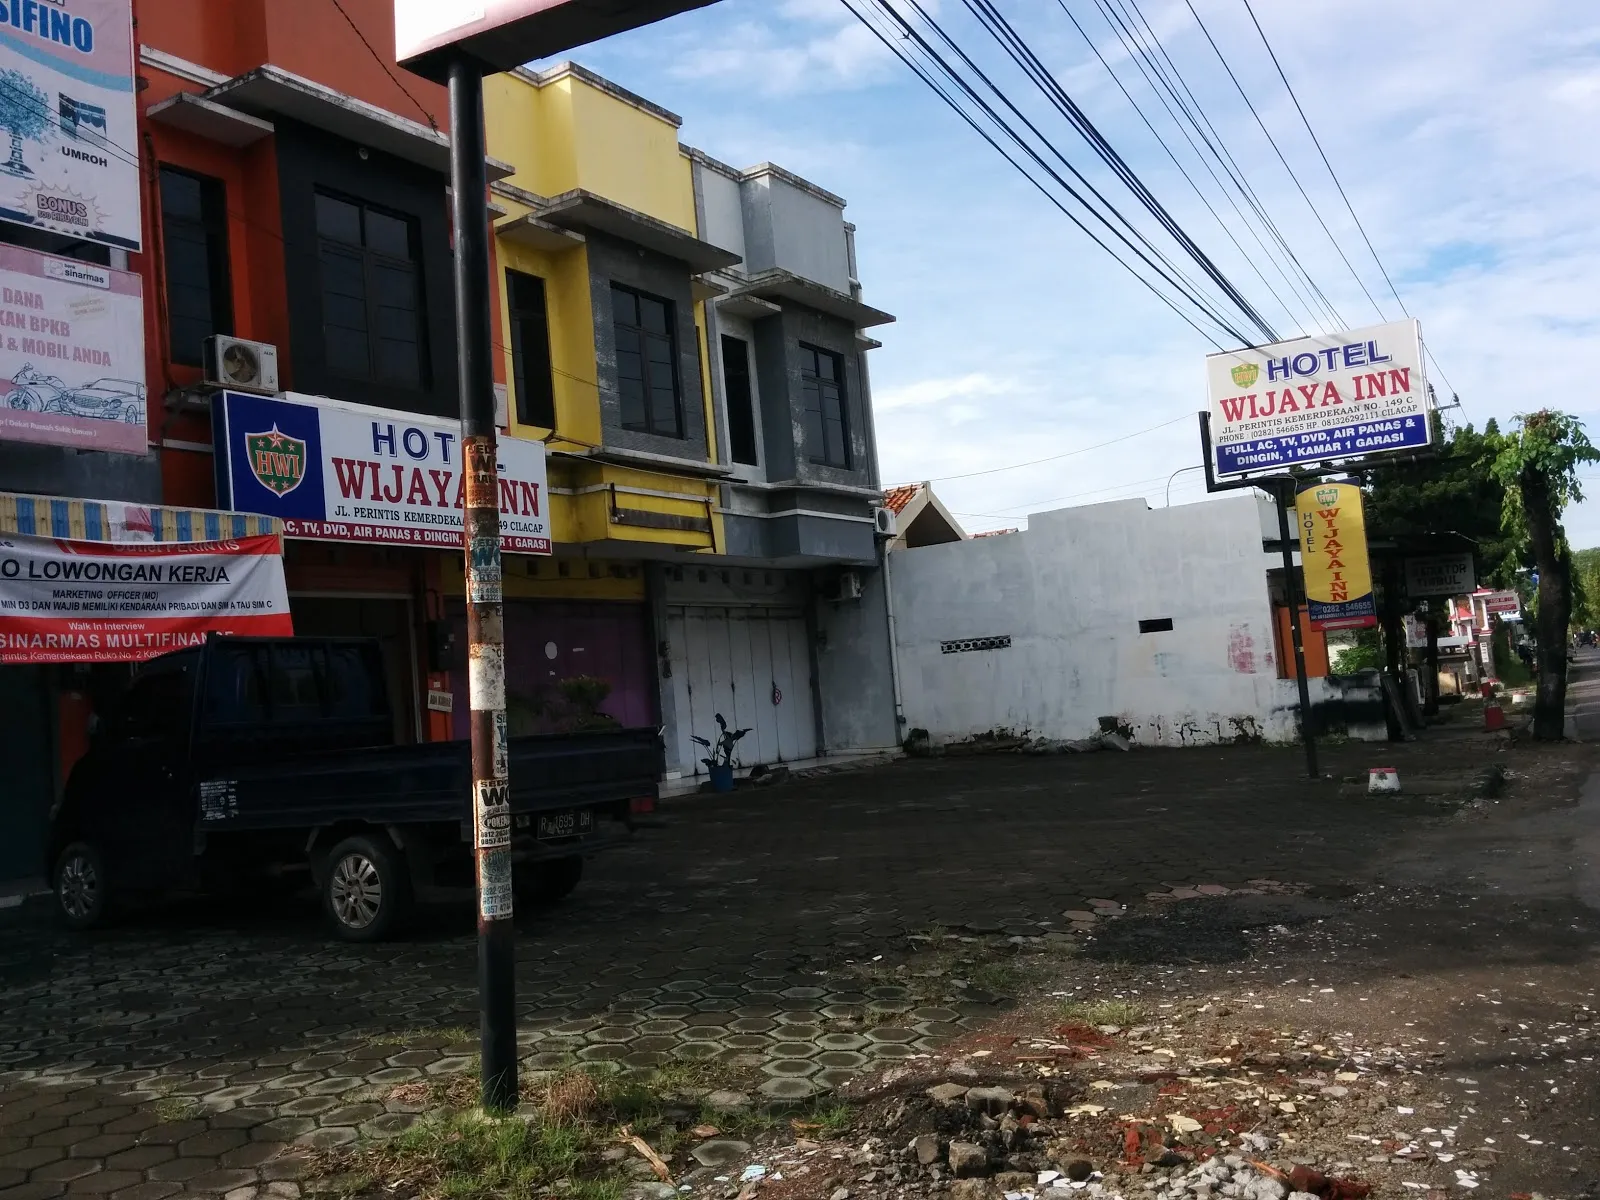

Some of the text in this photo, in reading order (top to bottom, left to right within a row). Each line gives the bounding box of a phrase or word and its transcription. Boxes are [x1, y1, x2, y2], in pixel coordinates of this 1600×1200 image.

[61, 146, 108, 168] UMROH
[36, 194, 88, 217] BONUS
[64, 268, 105, 284] sinarmas
[3, 288, 45, 311] DANA
[30, 315, 71, 338] BPKB
[7, 337, 112, 367] & MOBIL ANDA
[1266, 339, 1393, 383] HOTEL
[1219, 367, 1411, 423] WIJAYA INN
[1219, 433, 1245, 443] PHONE
[1251, 428, 1274, 439] (0282)
[1276, 422, 1304, 435] 546655
[1381, 404, 1418, 418] CILACAP
[1222, 396, 1414, 434] JL. PERINTIS KEMERDEKAAN NO. 149 C
[1224, 418, 1416, 456] FULL AC, TV, DVD, AIR PANAS &
[1236, 433, 1405, 466] DINGIN, 1 KAMAR 1 GARASI
[254, 449, 301, 479] HWI
[498, 478, 540, 518] NN
[334, 504, 351, 517] JL.
[353, 507, 400, 522] PERINTIS
[403, 511, 465, 526] KEMERDEKA
[510, 520, 544, 534] CILACAP
[1303, 512, 1316, 553] HOTEL
[303, 521, 322, 537] TV,
[323, 523, 351, 539] DVD,
[353, 525, 374, 538] AIR
[375, 527, 412, 541] PANAS
[413, 529, 423, 542] &
[424, 530, 463, 546] DINGIN,
[508, 537, 512, 546] 1
[515, 539, 548, 551] GARASI
[1315, 507, 1346, 570] WIJAYA
[29, 560, 162, 582] LOWONGAN
[169, 564, 230, 583] KERJA
[1329, 571, 1348, 602] INN
[1, 600, 17, 609] MIN
[18, 601, 30, 609] D3
[31, 601, 52, 610] DAN
[53, 602, 80, 611] WAJIB
[82, 602, 118, 611] MEMILIKI
[119, 602, 167, 611] KENDARAAN
[168, 602, 200, 610] PRIBADI
[202, 602, 217, 610] DAN
[218, 602, 229, 610] SIM
[252, 601, 265, 609] SIM
[266, 600, 273, 608] C
[52, 589, 159, 600] MARKETING OFFICER (MO)
[1322, 605, 1340, 614] 0282
[1345, 601, 1372, 611] 546655
[0, 631, 234, 649] SINARMAS MULTIFINAN
[68, 622, 146, 631] Walk In Interview
[30, 651, 93, 660] Kemerdekaan
[94, 651, 118, 660] Ruko
[119, 651, 132, 659] No.
[135, 650, 141, 659] 2
[541, 811, 591, 831] R 1695 DH
